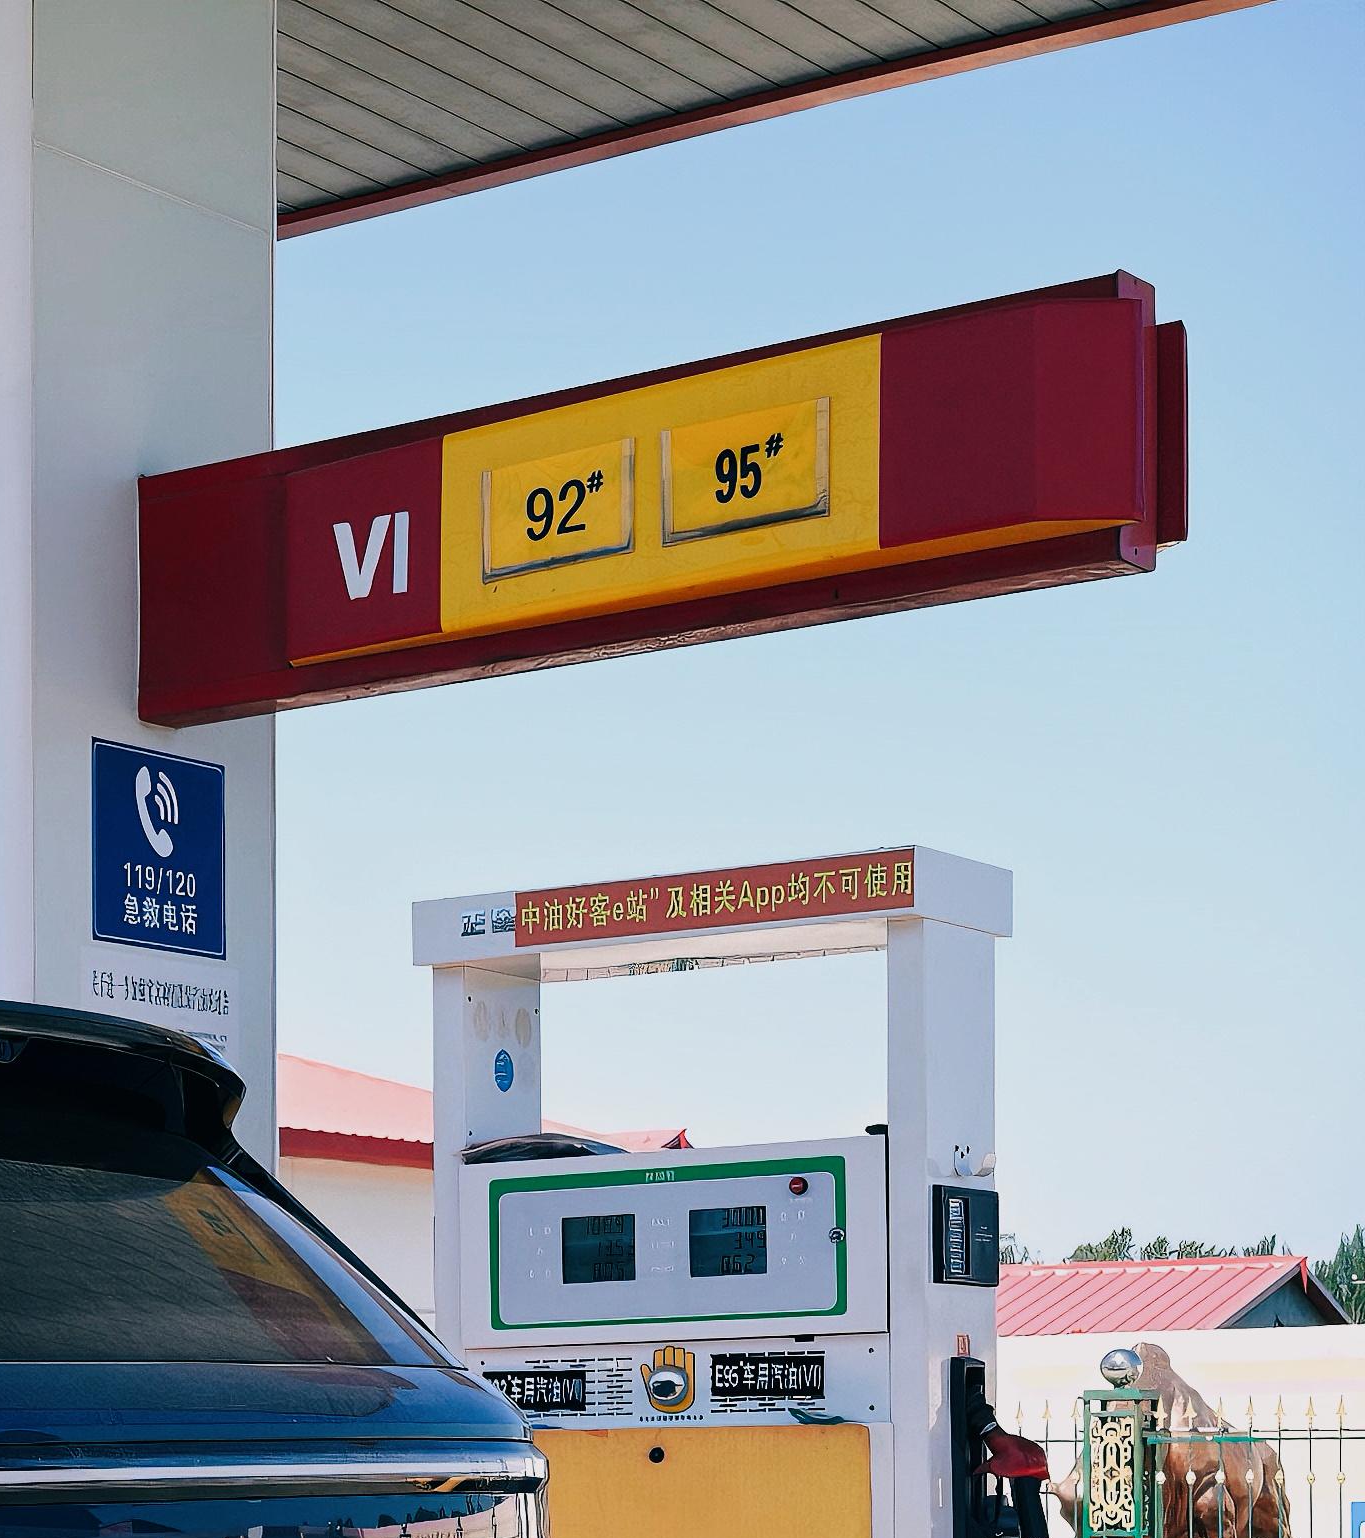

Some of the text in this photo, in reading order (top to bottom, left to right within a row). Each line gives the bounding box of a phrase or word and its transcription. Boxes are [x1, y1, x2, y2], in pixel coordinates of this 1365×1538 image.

[333, 432, 784, 600] VI 92# 95#
[123, 862, 197, 898] 119/120
[123, 893, 198, 935] 急救电话
